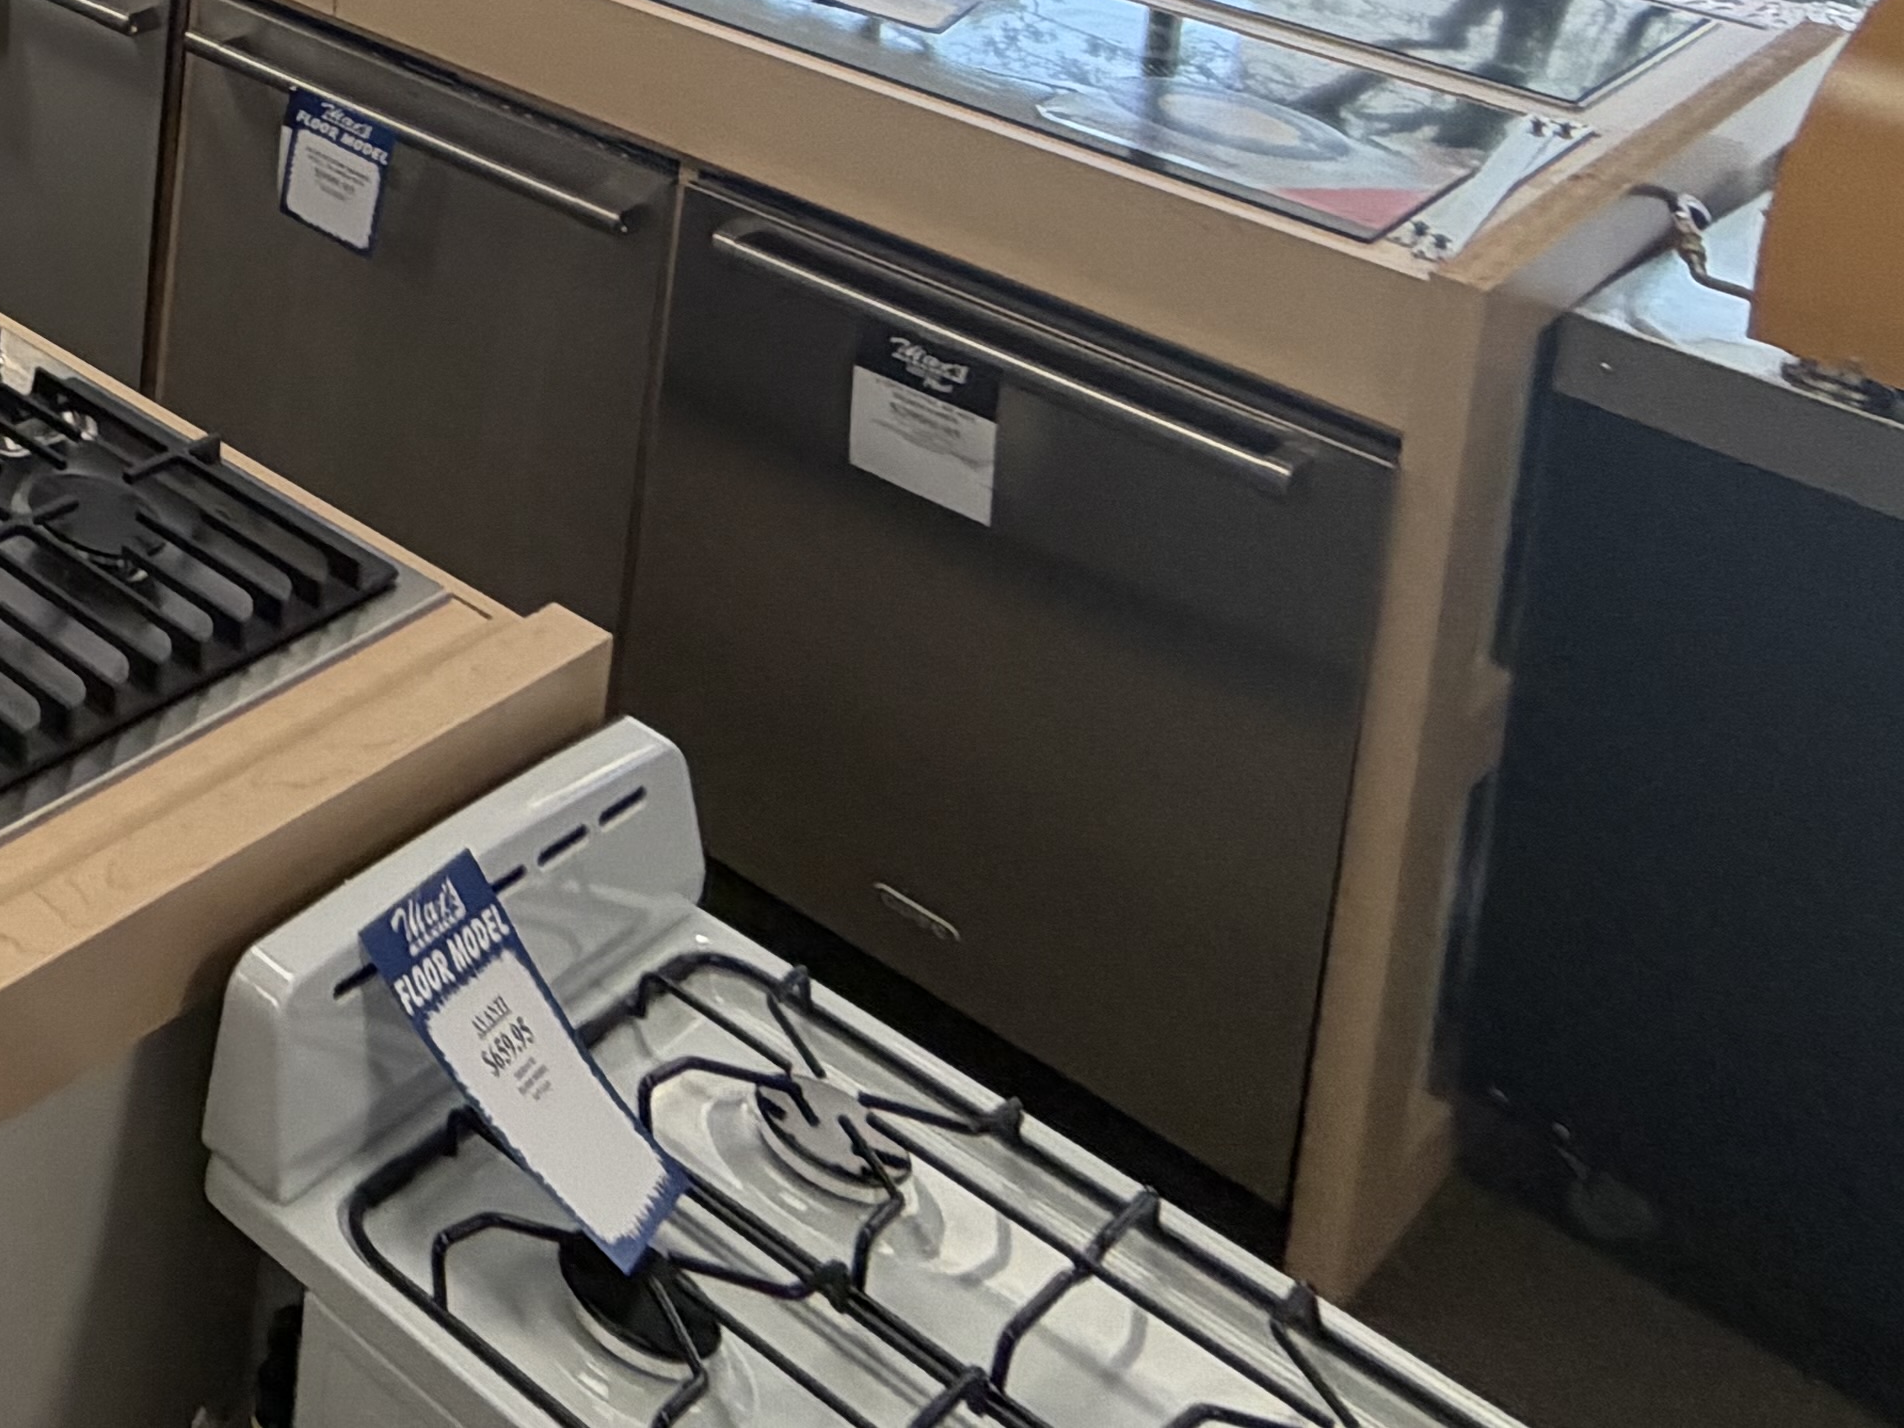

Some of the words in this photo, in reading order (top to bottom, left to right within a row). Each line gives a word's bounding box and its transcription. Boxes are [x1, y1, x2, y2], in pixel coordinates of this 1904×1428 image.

[296, 109, 341, 141] FLOOR
[340, 132, 389, 166] MODEL
[393, 948, 456, 1017] FLOOR
[446, 904, 511, 973] MODEL
[480, 1016, 536, 1078] $659.95
